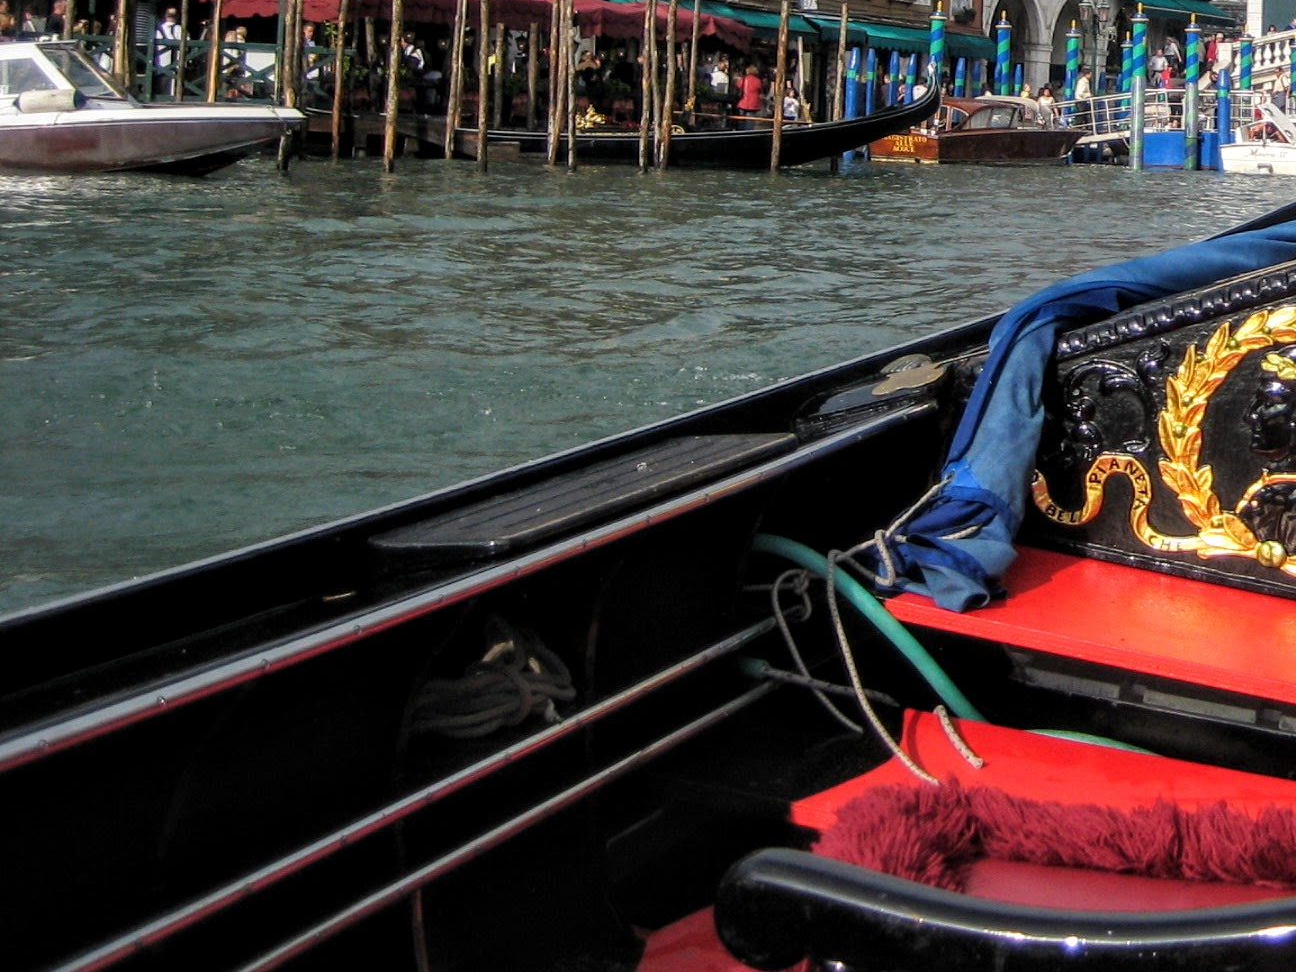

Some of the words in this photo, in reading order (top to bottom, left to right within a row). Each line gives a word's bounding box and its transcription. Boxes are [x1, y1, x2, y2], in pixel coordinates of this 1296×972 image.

[1045, 504, 1077, 524] BEL
[1088, 458, 1149, 510] PIANETA
[1148, 534, 1183, 551] CHE
